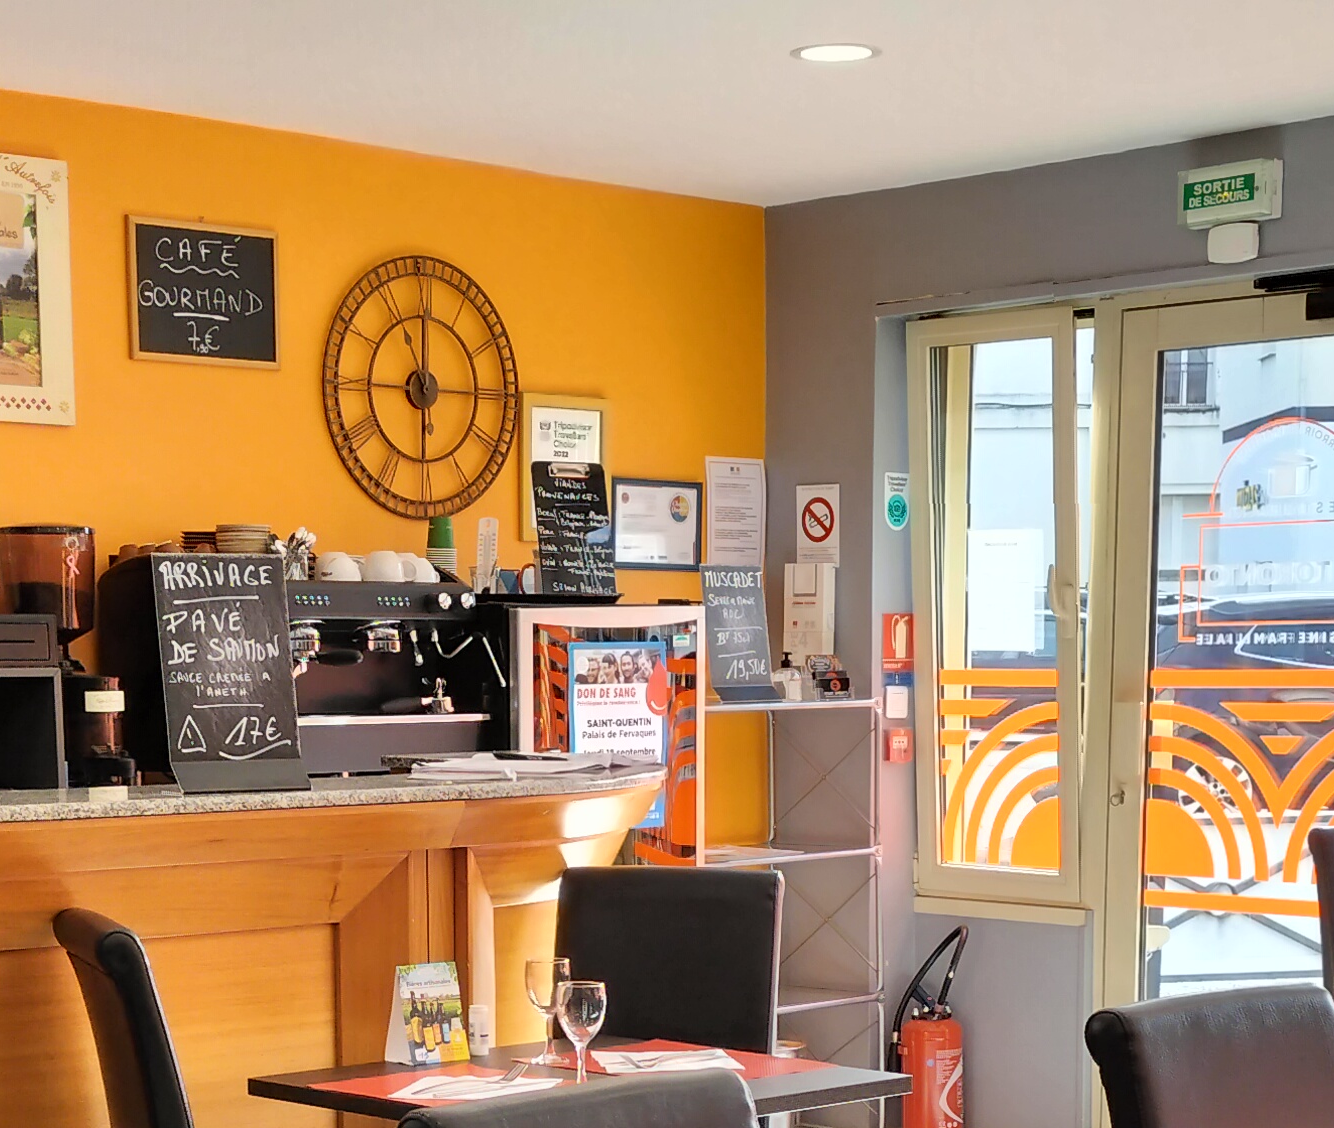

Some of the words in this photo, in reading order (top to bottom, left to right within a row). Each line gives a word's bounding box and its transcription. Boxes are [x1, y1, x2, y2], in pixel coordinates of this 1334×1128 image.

[1193, 177, 1245, 195] SORTIE
[1189, 197, 1202, 208] DE
[1203, 189, 1249, 205] SECOURS
[155, 236, 241, 267] CAFÉ
[138, 279, 263, 316] GOURMAND
[158, 560, 273, 590] ARRIVAGE
[705, 571, 762, 588] MUSCADET
[162, 602, 241, 633] PAVÉ
[168, 640, 198, 665] DE
[207, 634, 280, 664] SAUMON
[169, 672, 203, 684] SAUCE
[726, 658, 767, 680] 19,50€
[577, 688, 596, 699] DON
[599, 688, 610, 698] DE
[613, 687, 636, 698] SANG
[225, 717, 282, 745] 17€
[587, 717, 652, 727] SAINT-QUENTIN
[582, 731, 605, 739] Palais
[607, 730, 617, 738] de
[619, 729, 656, 738] Fervaques
